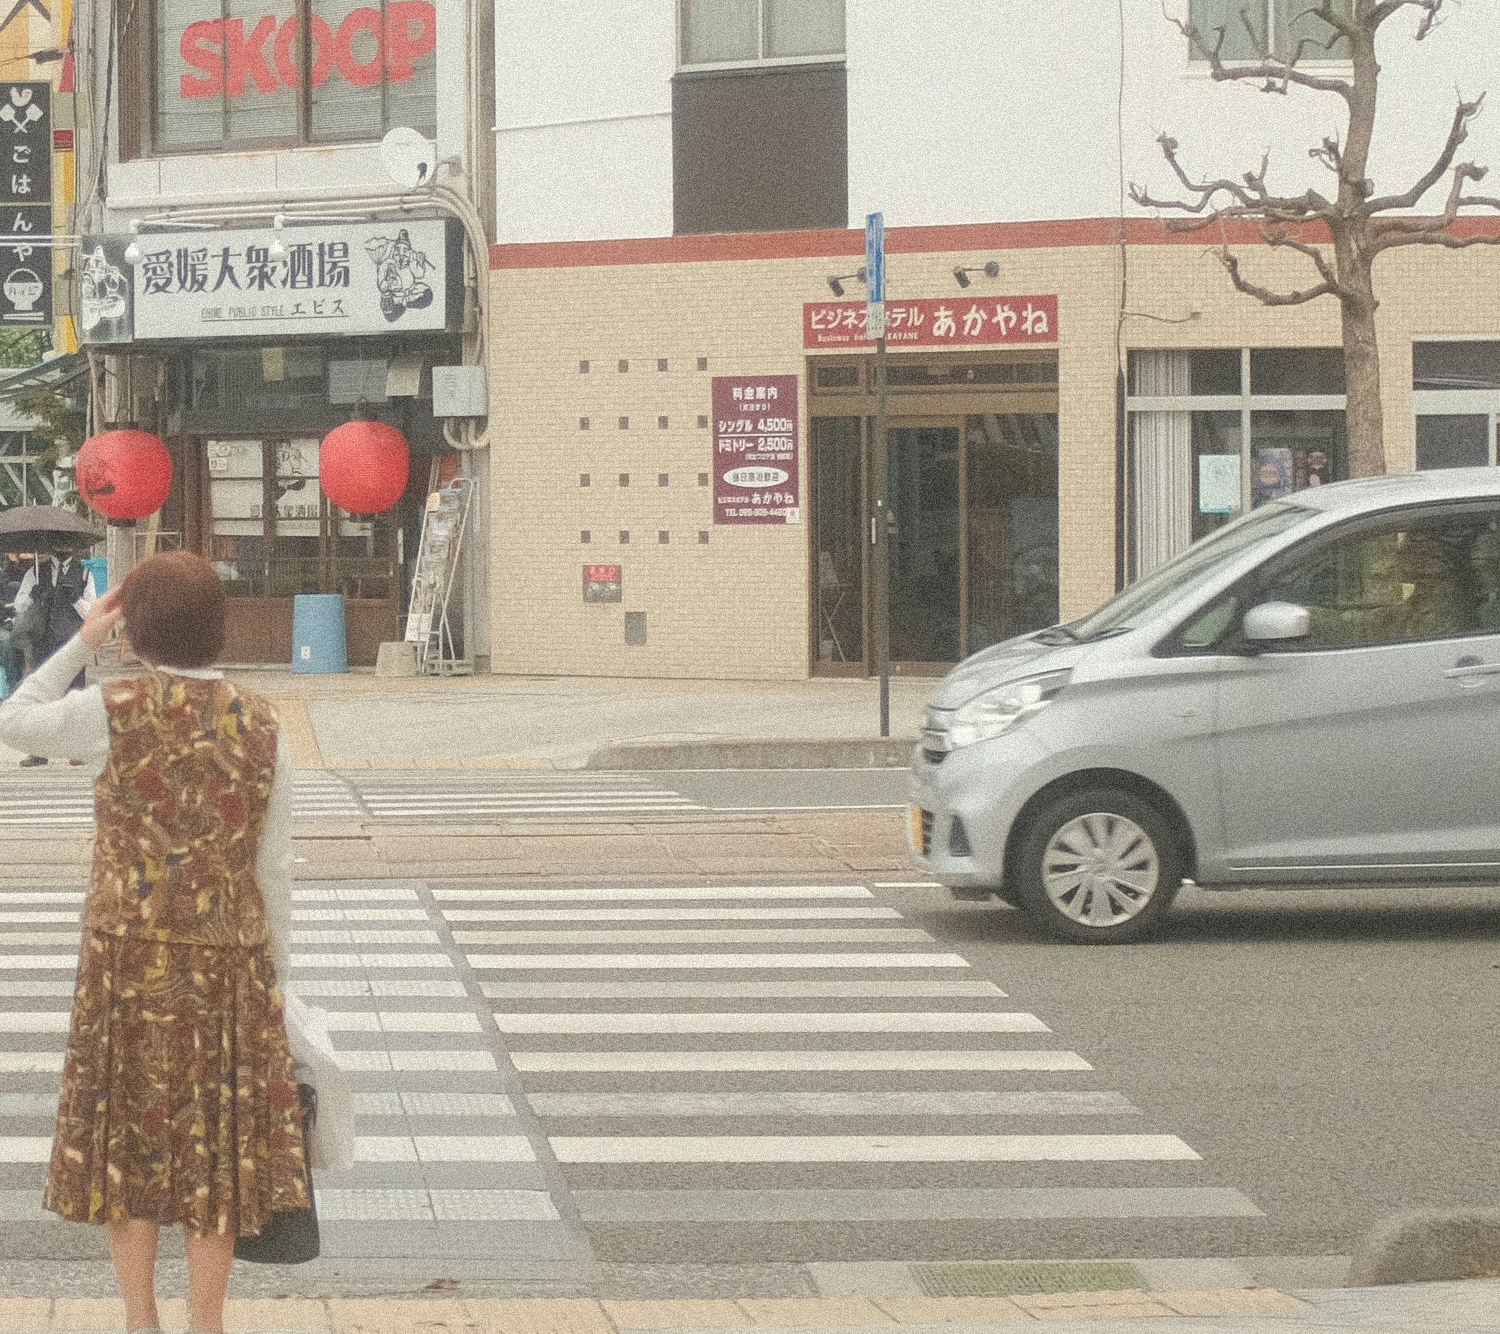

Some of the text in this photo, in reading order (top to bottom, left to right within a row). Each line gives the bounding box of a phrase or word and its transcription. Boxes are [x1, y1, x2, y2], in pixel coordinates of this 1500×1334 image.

[179, 0, 437, 99] SKOOP
[12, 144, 34, 263] ごはんや
[141, 240, 351, 294] 愛媛大衆酒場
[291, 298, 345, 315] エビス
[932, 302, 1050, 339] あかやね
[718, 418, 793, 433] シングル 4,500円
[718, 437, 794, 453] ドミトリー 2,500円
[751, 491, 795, 505] あかやね
